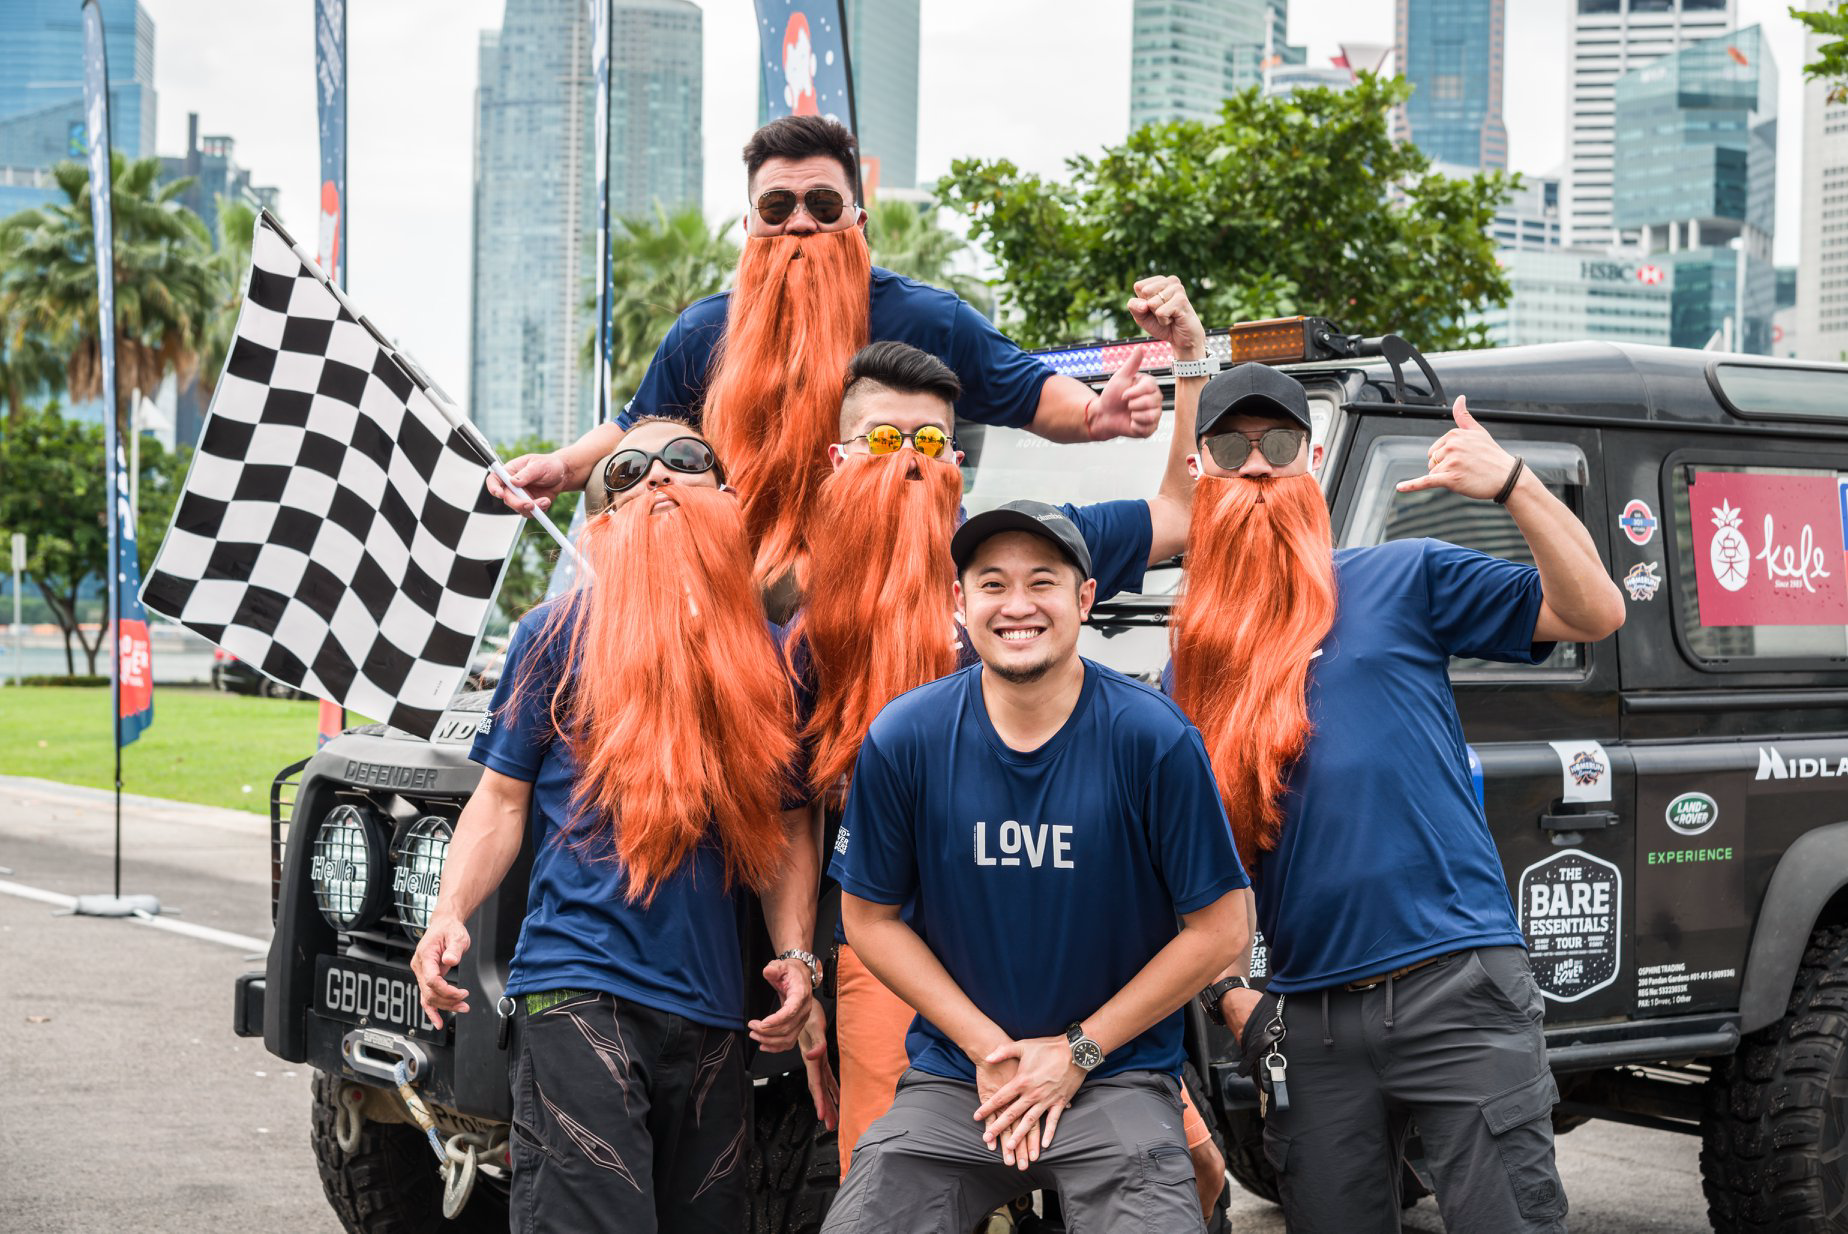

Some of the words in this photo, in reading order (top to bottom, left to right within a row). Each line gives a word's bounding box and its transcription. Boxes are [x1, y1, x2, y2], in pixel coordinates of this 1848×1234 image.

[1581, 262, 1634, 283] HSBC
[344, 760, 439, 790] DEFENDER
[1677, 801, 1701, 813] LAND
[1679, 811, 1709, 825] ROVER
[976, 820, 1074, 869] LOVE
[1648, 848, 1733, 865] EXPERIENCE
[311, 856, 356, 883] Hella
[1559, 867, 1582, 881] THE
[393, 866, 441, 896] Hella
[1530, 882, 1610, 917] BARE
[1530, 916, 1609, 935] ESSENTIALS
[1555, 936, 1583, 949] TOUR
[1553, 965, 1584, 986] ROVER
[1555, 958, 1573, 976] LAND
[1661, 963, 1685, 973] TRADING
[1649, 976, 1667, 985] Pandan
[1668, 974, 1690, 983] Gardens
[1638, 988, 1649, 997] REG
